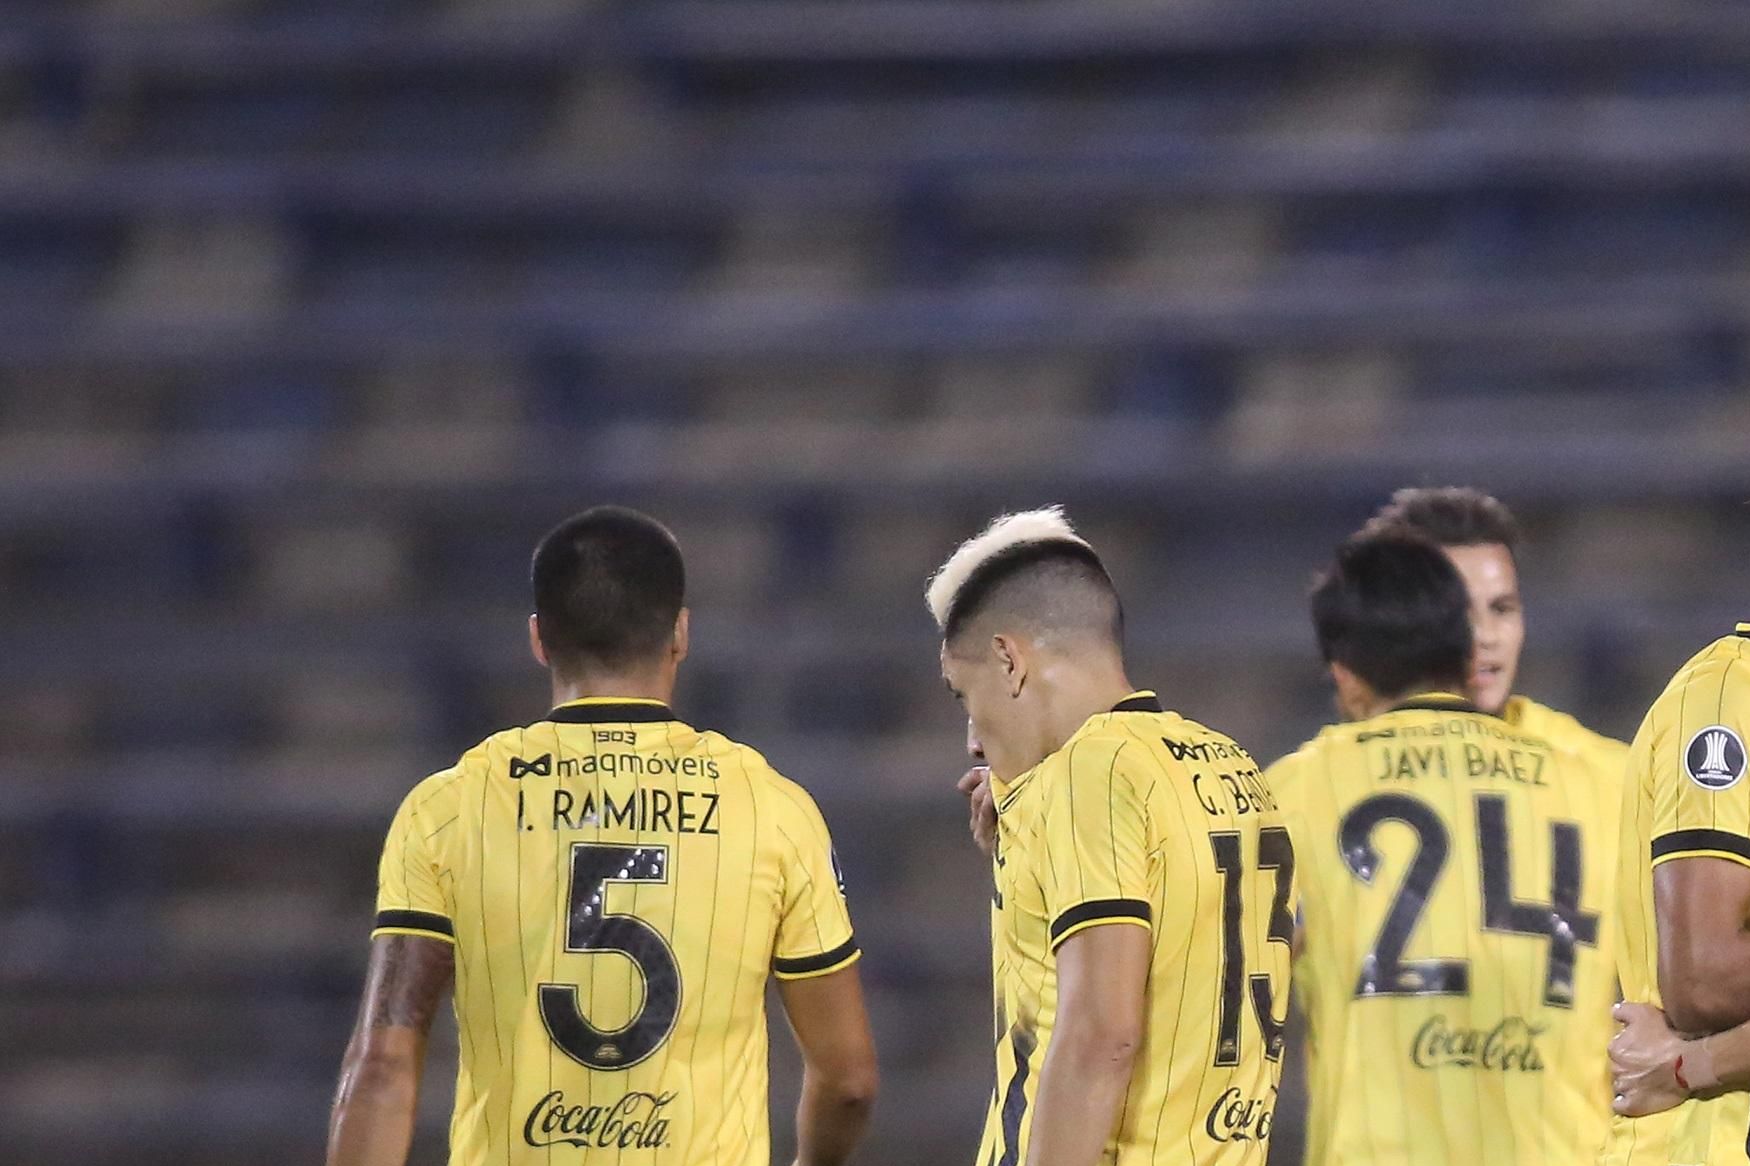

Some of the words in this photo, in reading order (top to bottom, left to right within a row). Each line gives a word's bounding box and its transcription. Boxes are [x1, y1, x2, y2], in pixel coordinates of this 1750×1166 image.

[592, 730, 637, 746] 1903
[556, 752, 720, 780] maqmóveis
[1379, 746, 1448, 780] JAVI
[1463, 742, 1549, 786] BAEZ
[517, 789, 535, 832] I.
[553, 788, 720, 834] RAMIREZ
[1337, 790, 1598, 1008] 24
[537, 842, 683, 1071] 5
[1209, 825, 1295, 1067] 13
